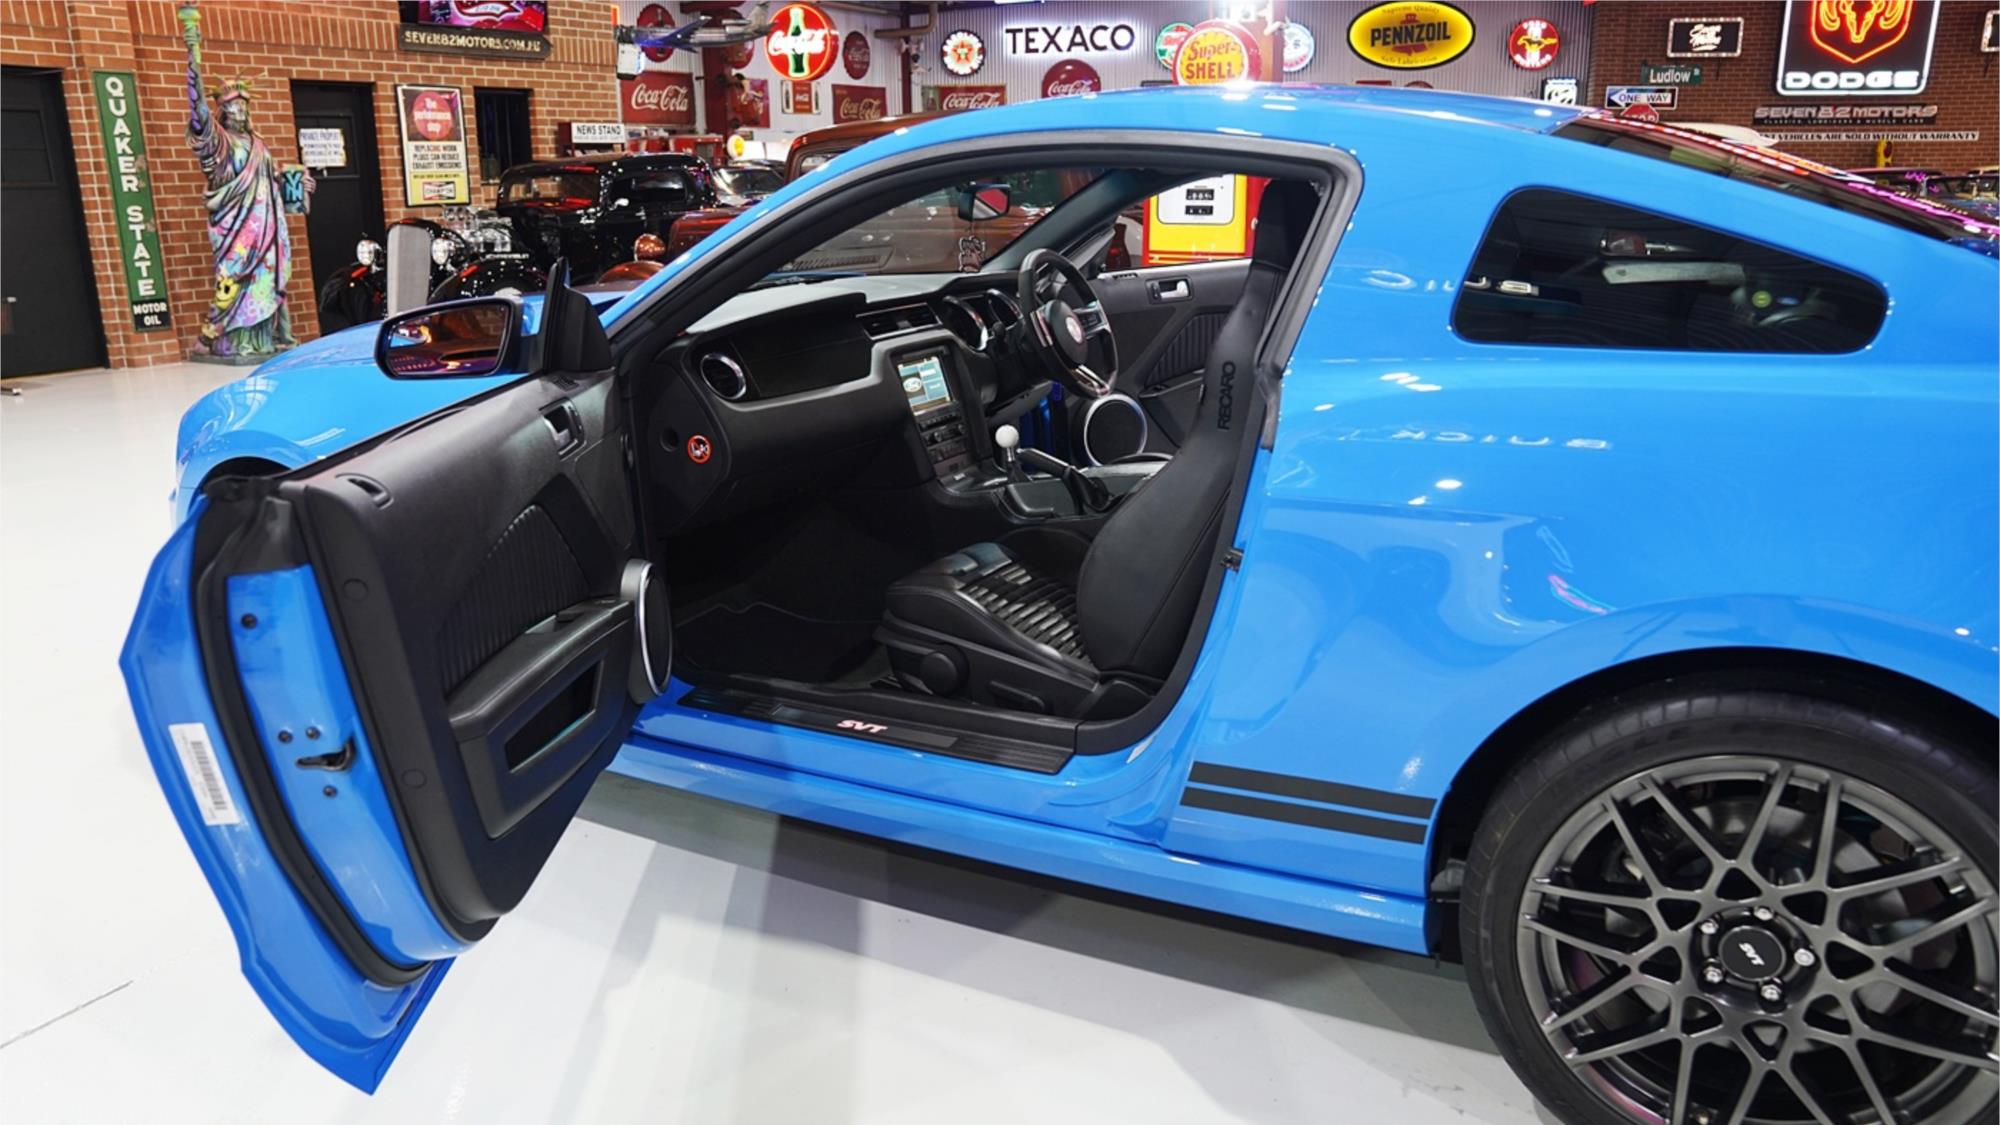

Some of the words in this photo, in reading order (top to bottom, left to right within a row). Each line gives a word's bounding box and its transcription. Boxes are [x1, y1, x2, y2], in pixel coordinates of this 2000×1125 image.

[1005, 24, 1136, 54] TEXACO
[1370, 21, 1452, 47] PENNZOIL
[1185, 62, 1236, 80] SHELL
[1649, 68, 1691, 83] Ludlow
[1785, 70, 1920, 89] DODGE
[631, 83, 689, 112] Coca-Cola
[1619, 94, 1641, 103] ONE
[1647, 93, 1669, 103] WAY
[840, 97, 882, 120] Coca-Cola
[1754, 106, 1818, 118] SEVEN
[1818, 105, 1852, 118] 82
[1852, 105, 1938, 118] MOTORS
[576, 125, 597, 136] NEWS
[598, 125, 621, 136] STAND
[1919, 132, 1977, 140] WARRANTY
[105, 76, 139, 193] QUAKER
[126, 205, 156, 297] STATE
[133, 301, 168, 315] MOTOR
[143, 315, 162, 326] OIL
[1217, 361, 1236, 430] RECARO
[837, 719, 888, 733] SVT
[1739, 942, 1766, 966] SVT
